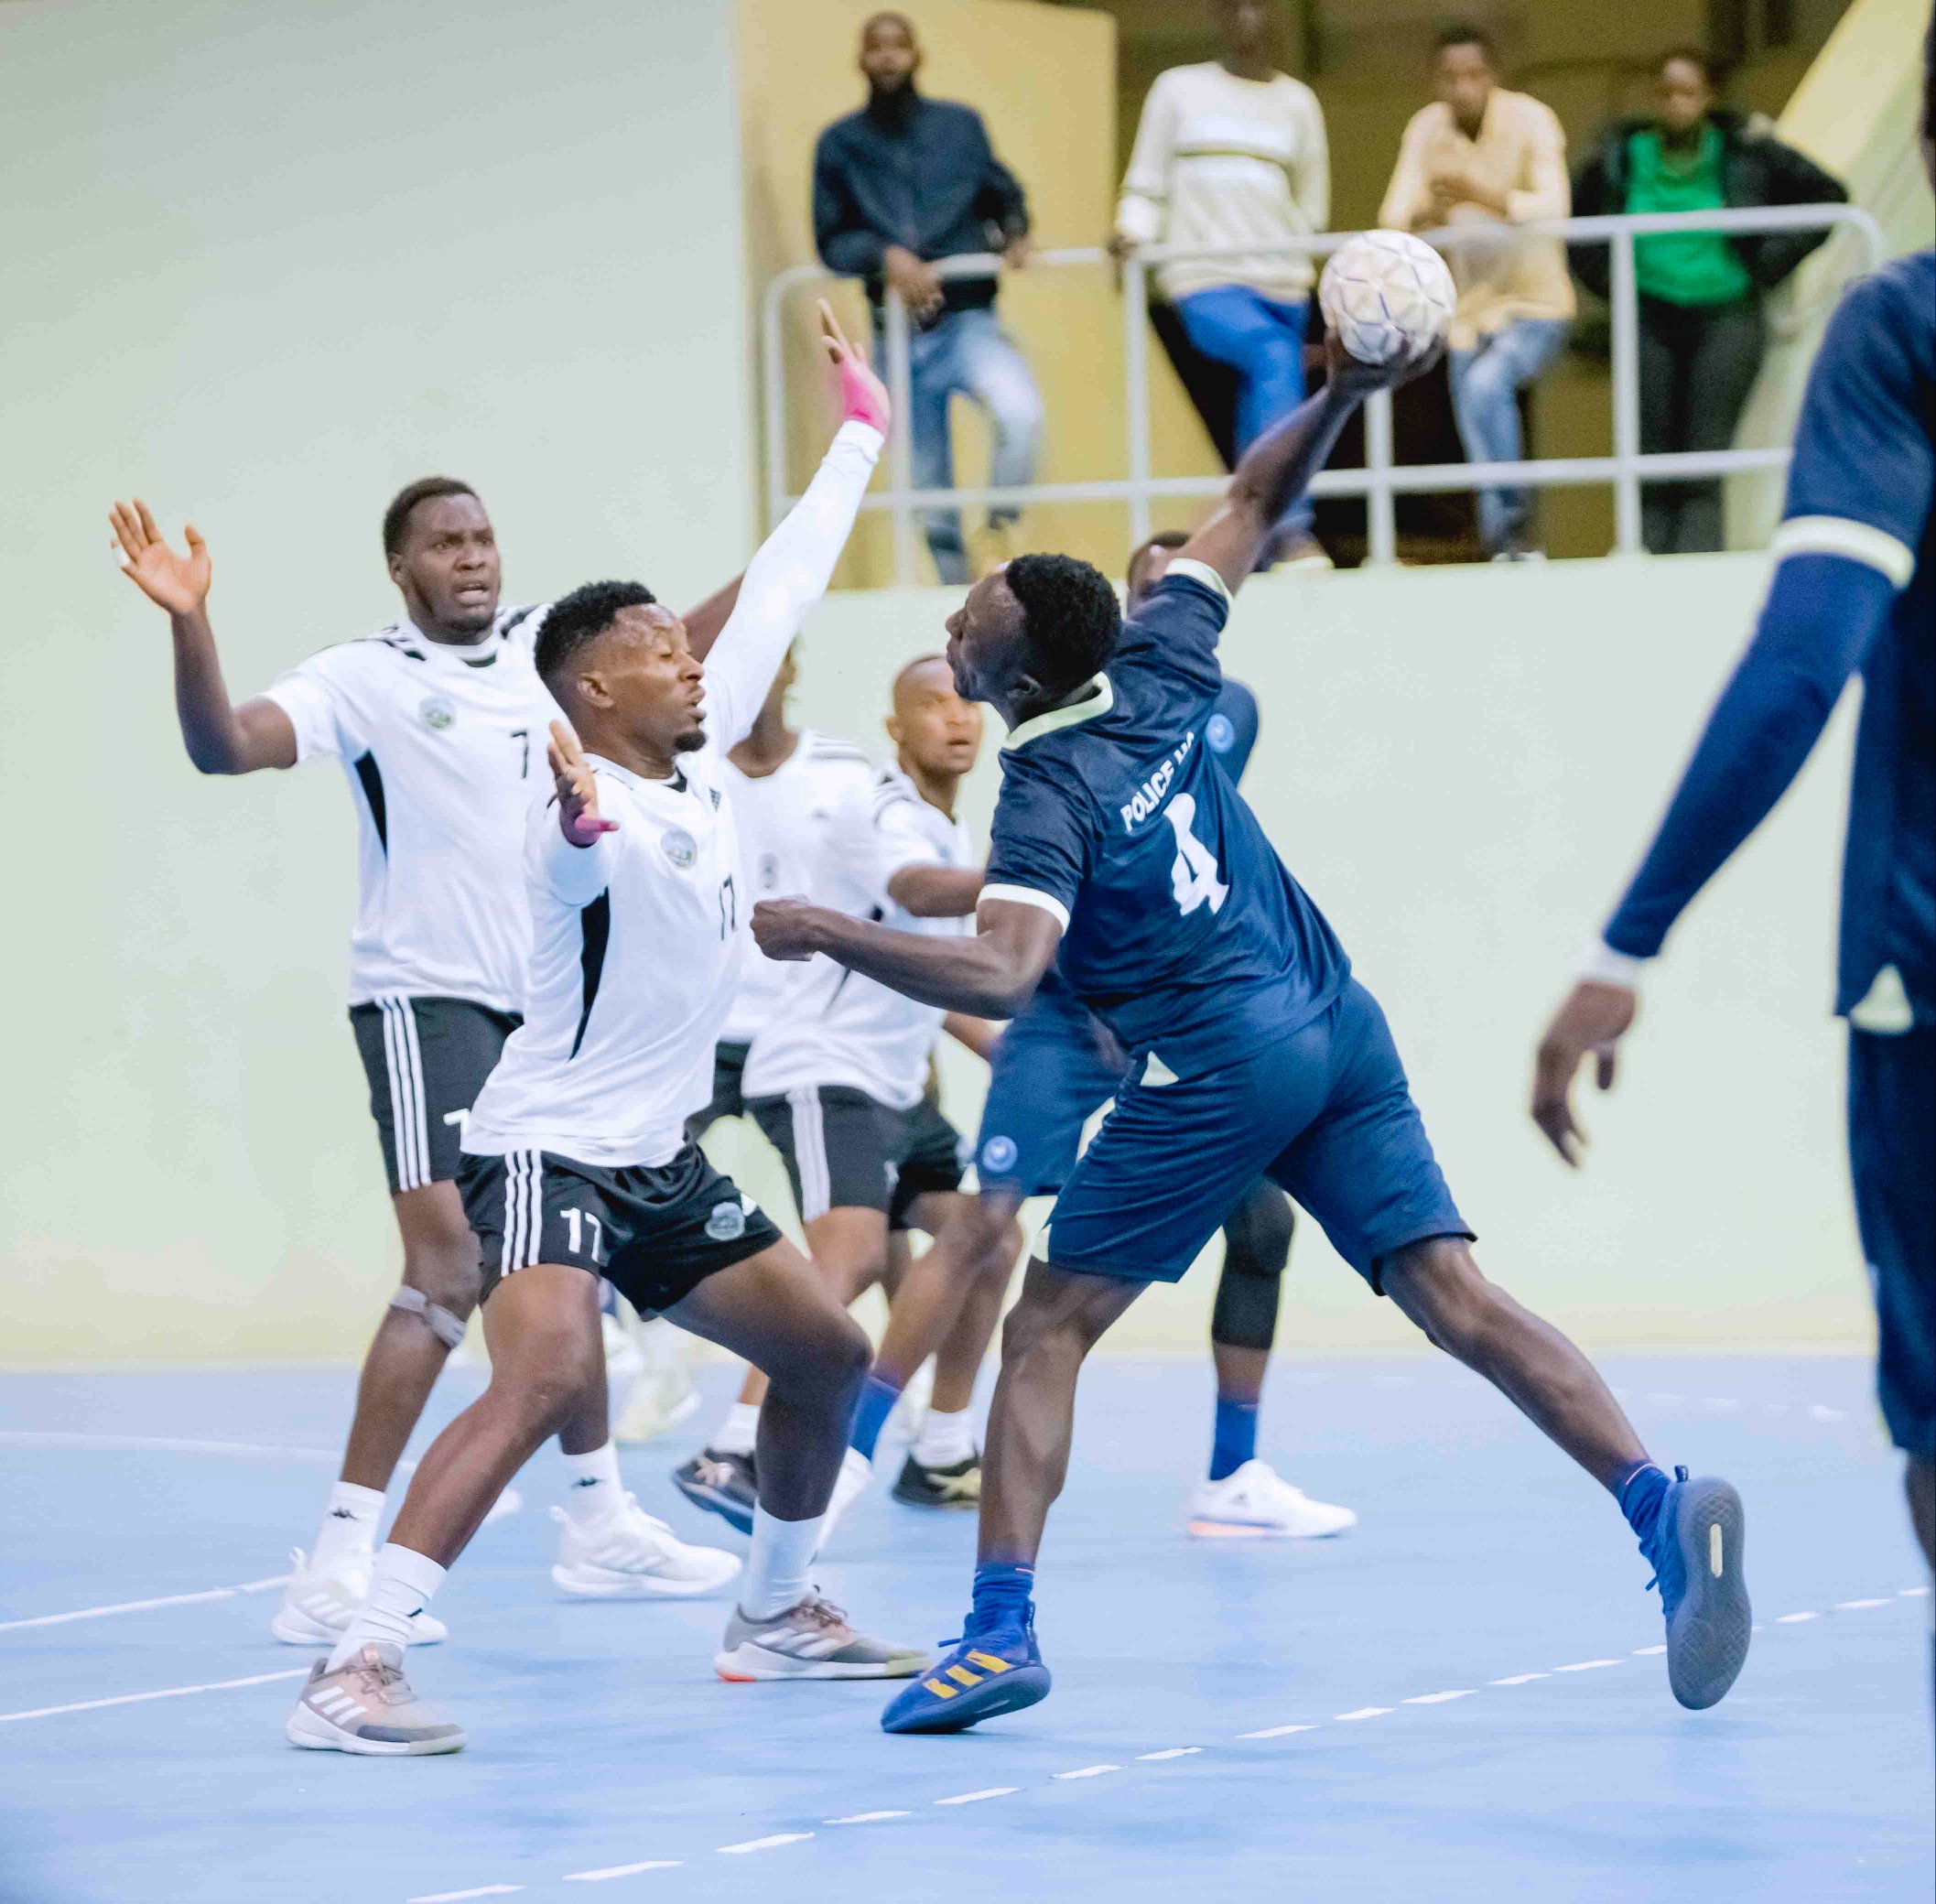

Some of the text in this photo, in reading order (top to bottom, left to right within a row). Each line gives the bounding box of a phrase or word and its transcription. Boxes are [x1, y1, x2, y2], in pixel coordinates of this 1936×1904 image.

[511, 730, 528, 779] 7
[1163, 793, 1229, 916] 4
[559, 1206, 602, 1262] 17
